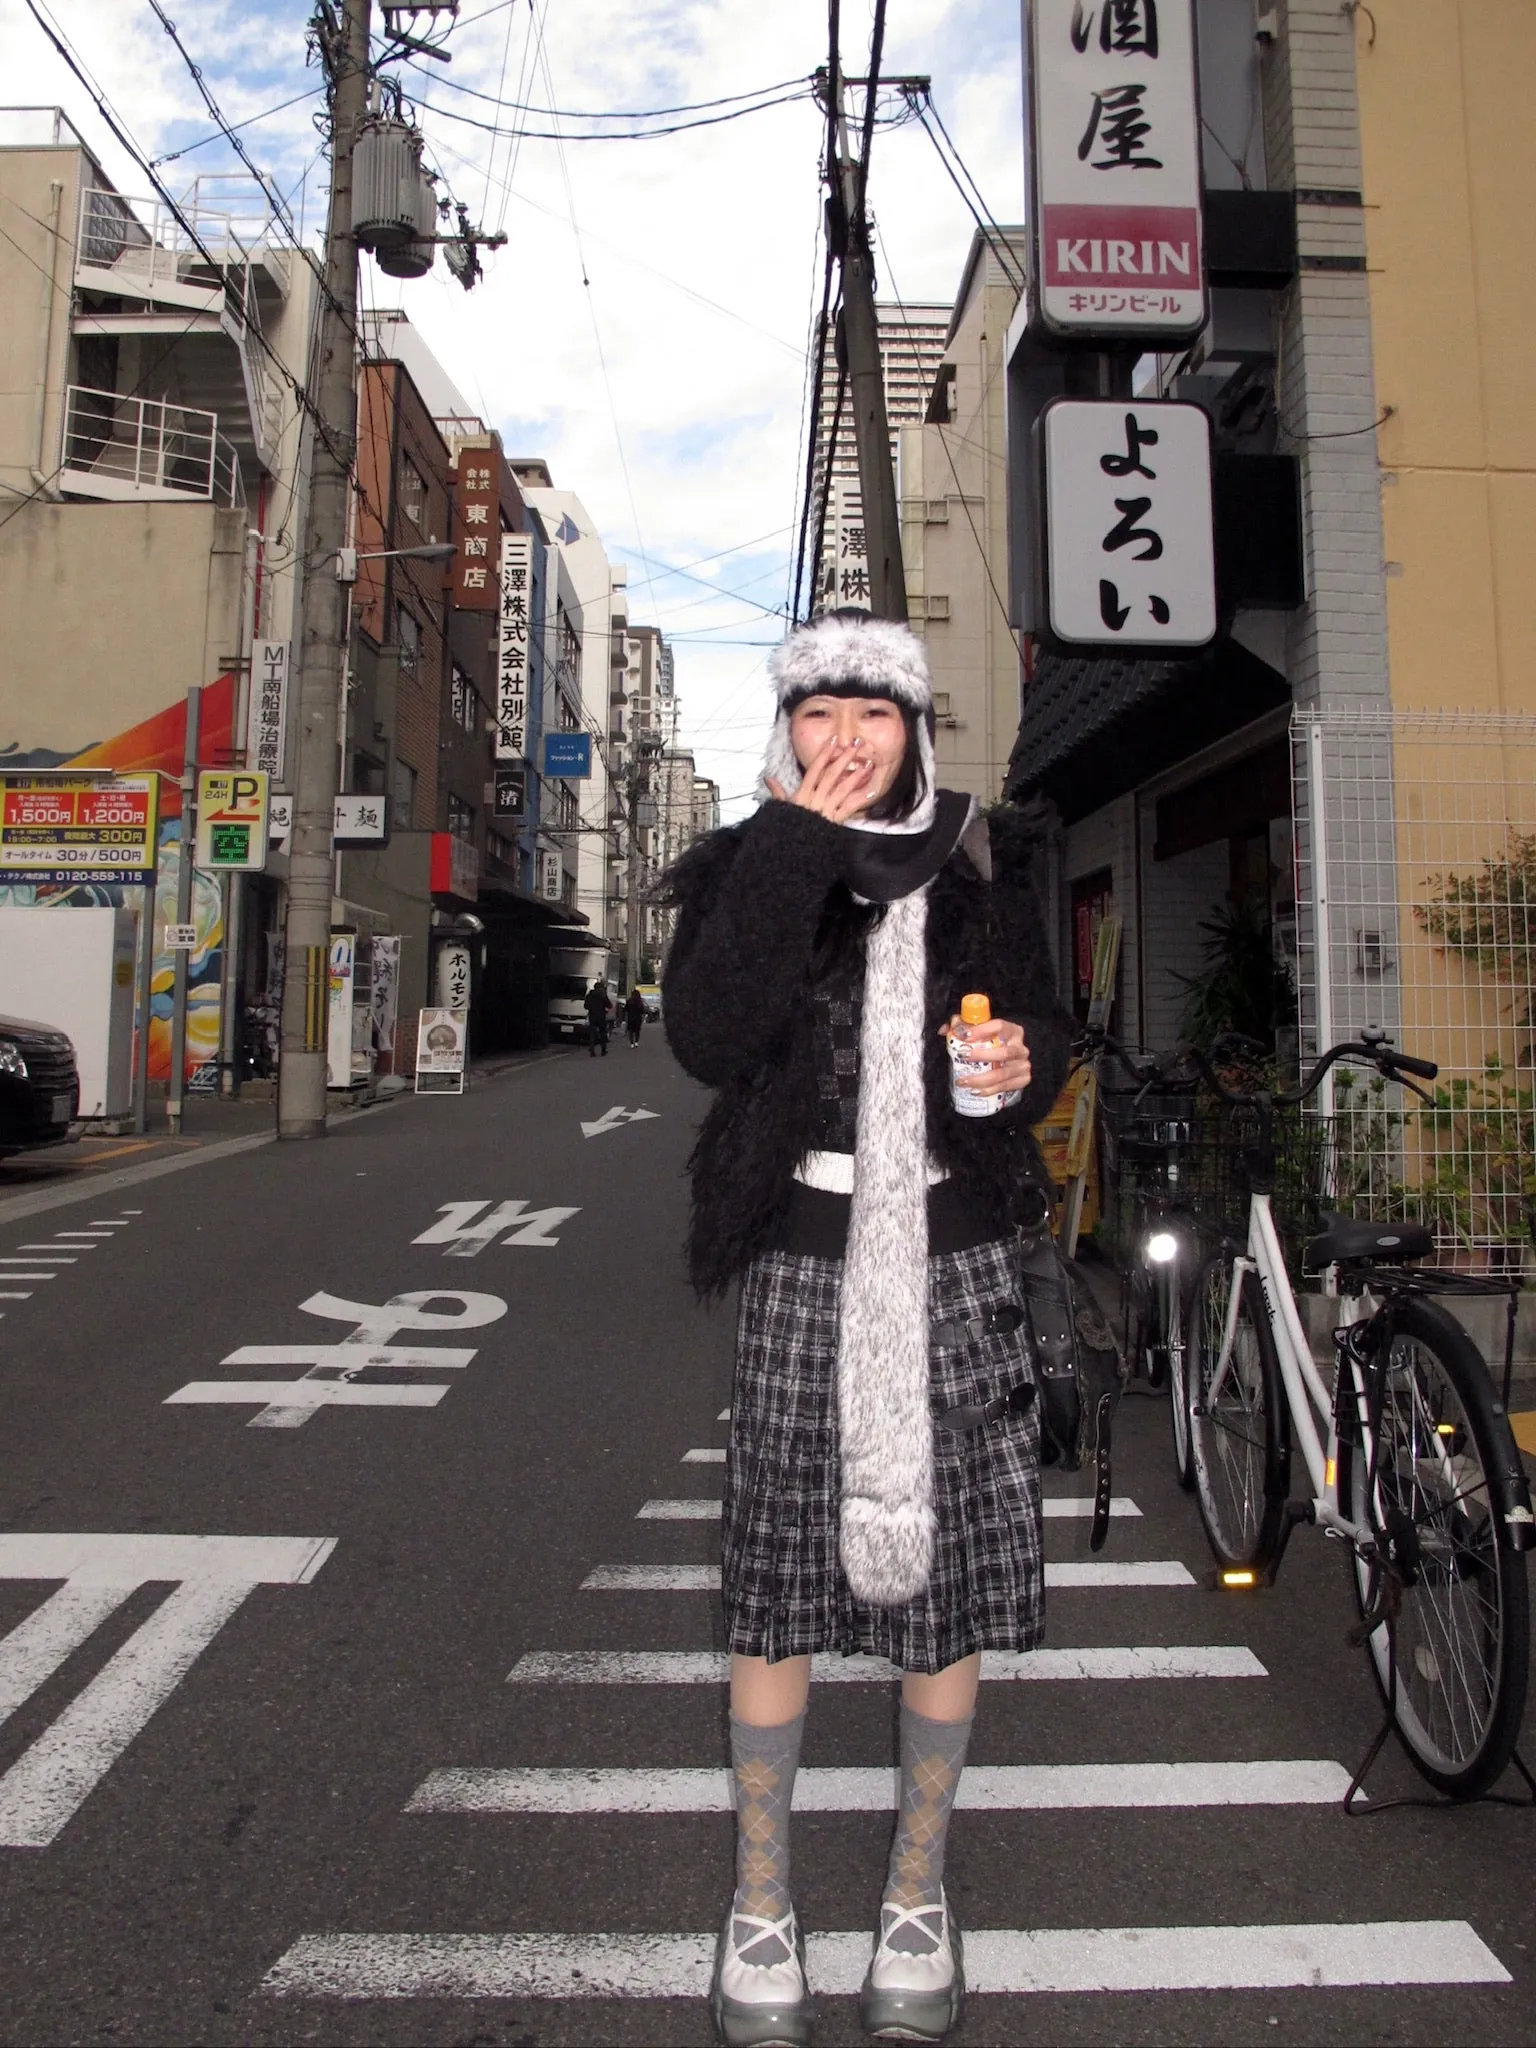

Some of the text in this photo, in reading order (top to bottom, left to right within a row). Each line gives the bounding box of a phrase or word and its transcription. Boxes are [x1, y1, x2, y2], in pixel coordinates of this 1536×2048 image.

[1056, 238, 1190, 275] KIRIN
[1069, 294, 1181, 314] キリンビール
[1100, 413, 1170, 632] よろい
[463, 503, 489, 589] 東商店
[499, 543, 528, 749] 三澤株式会社別館
[258, 646, 284, 776] MT南船場治療院
[204, 790, 228, 800] 24H
[231, 777, 259, 810] P
[10, 808, 71, 825] 1,500円
[83, 808, 145, 825] 1,200円
[99, 829, 143, 842] 300円
[210, 825, 250, 864] 空
[5, 851, 52, 860] オールタイム
[56, 871, 143, 881] 0120-559-115
[547, 857, 558, 897] 杉山商店
[449, 953, 466, 1008] ホルモン
